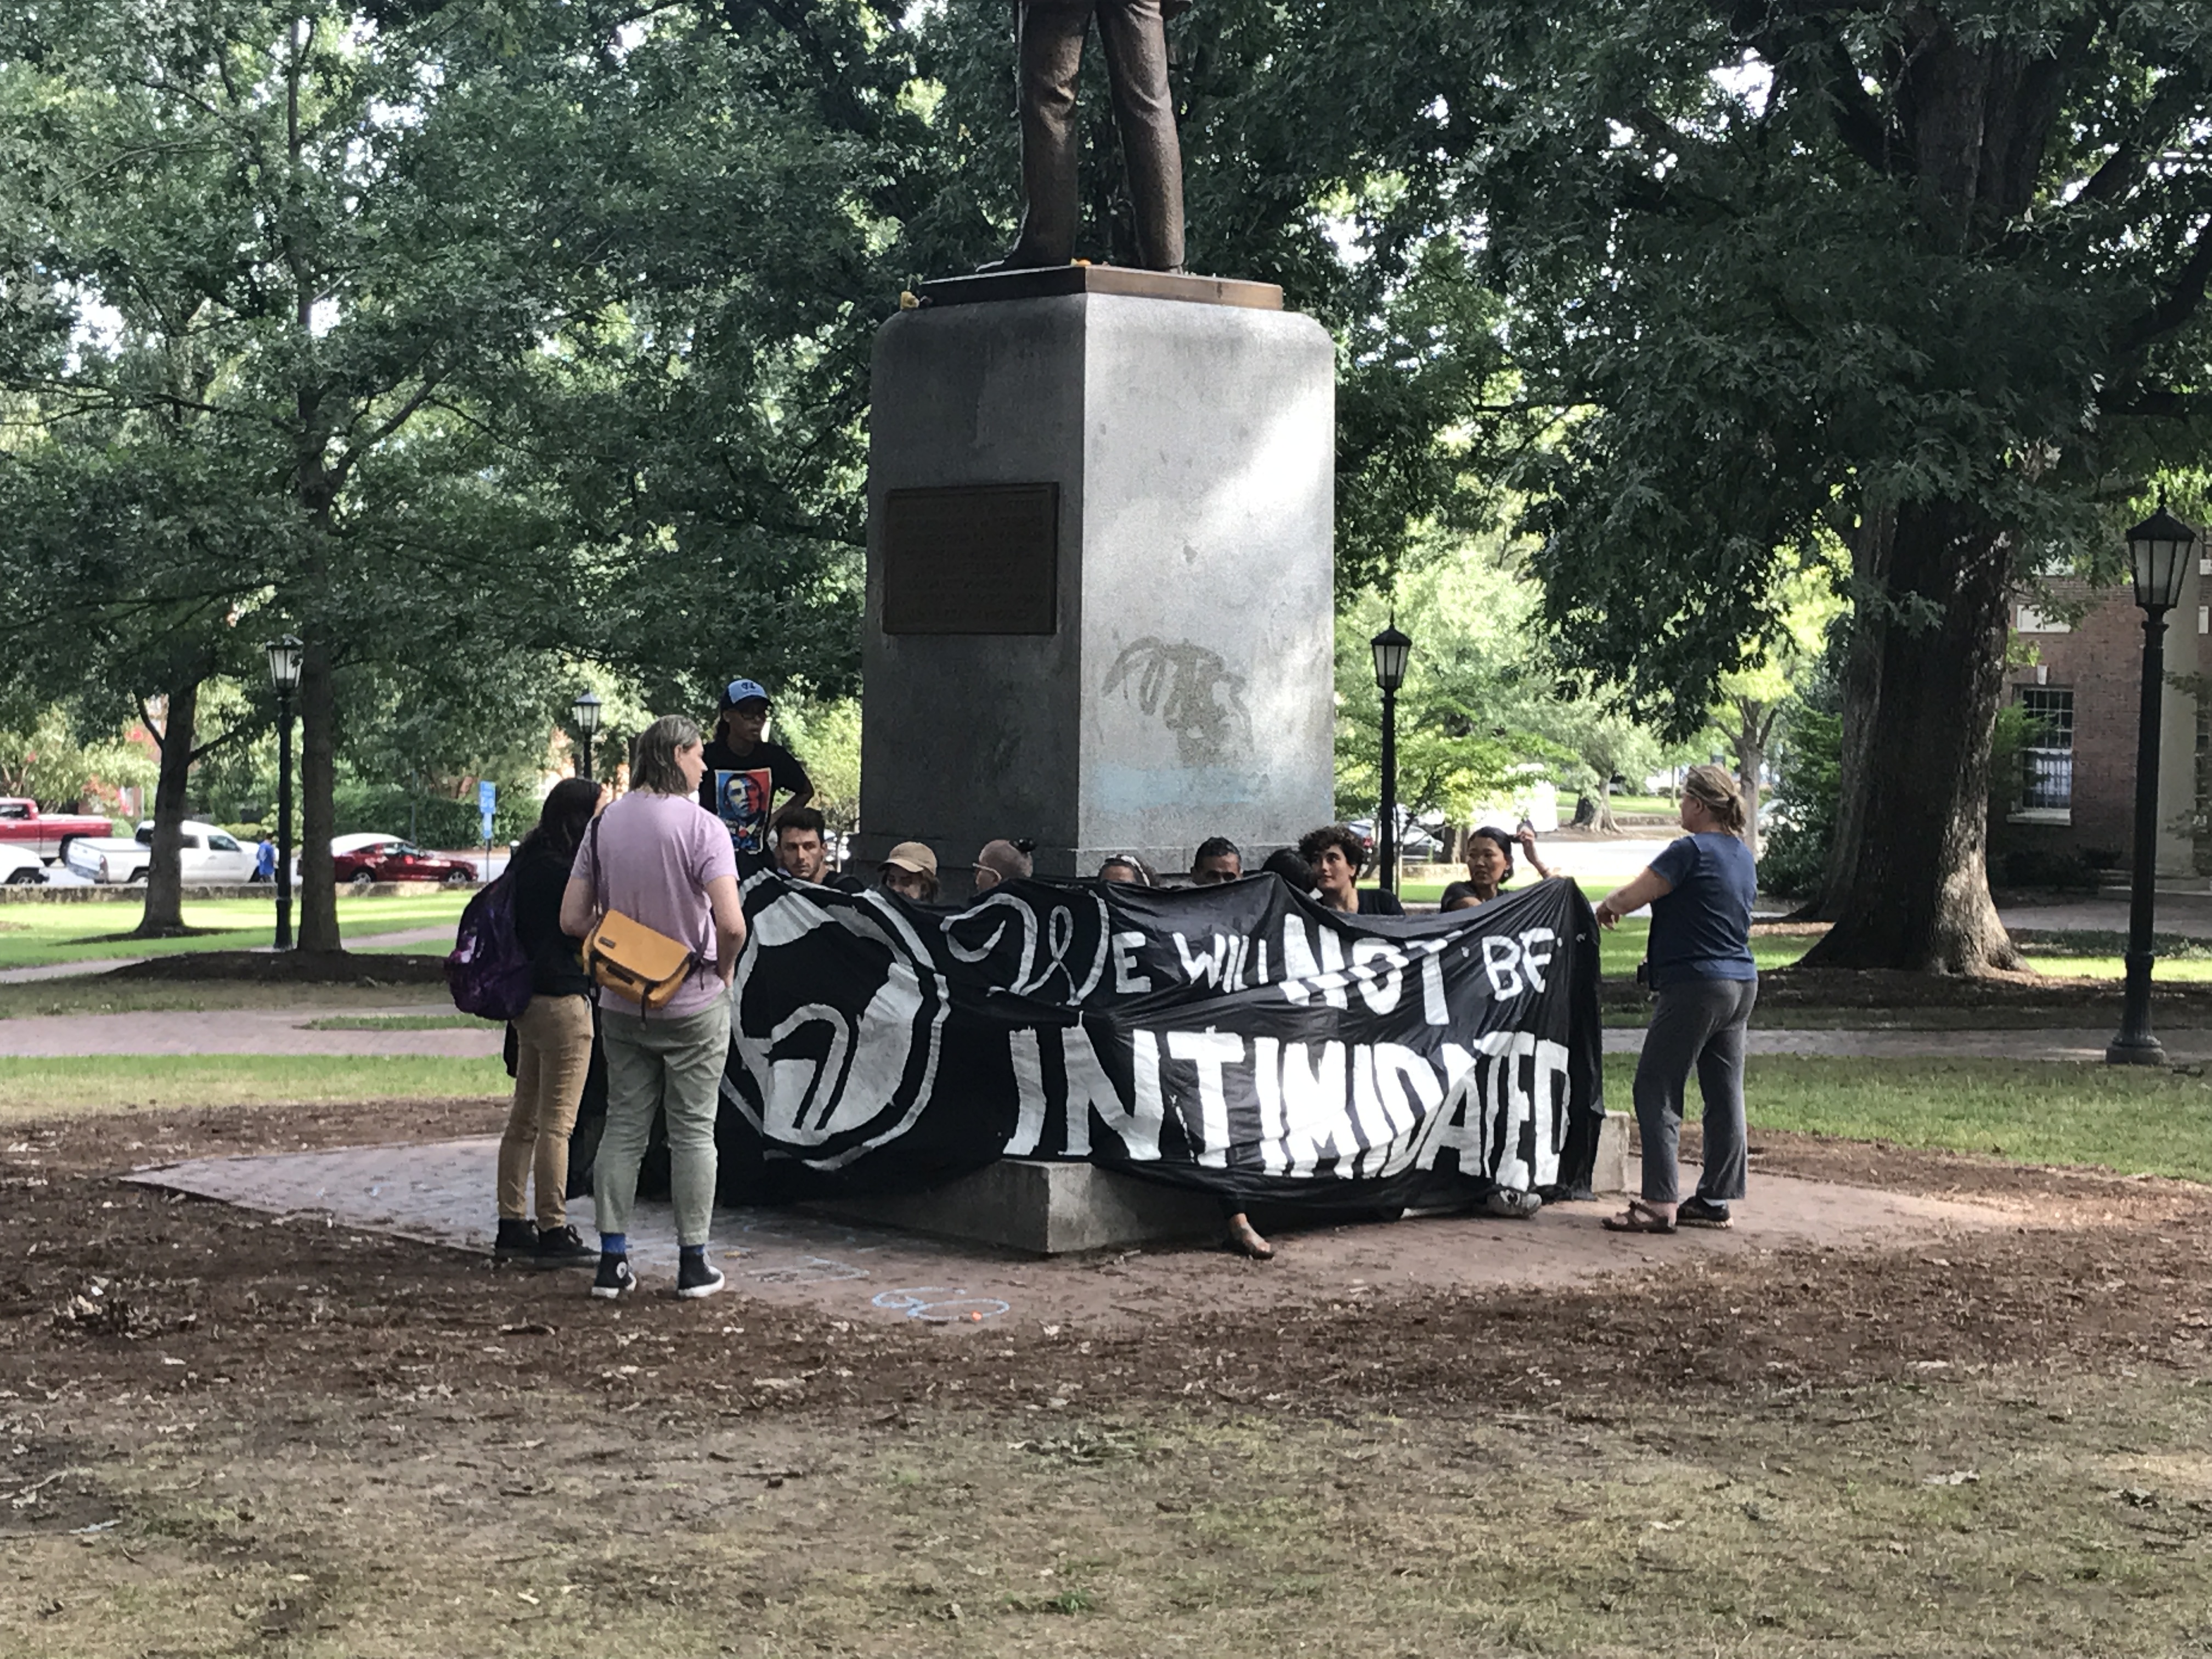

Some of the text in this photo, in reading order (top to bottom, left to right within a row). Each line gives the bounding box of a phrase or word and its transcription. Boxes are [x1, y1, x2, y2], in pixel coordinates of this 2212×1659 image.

[940, 889, 1555, 1025] WE WILL NOT BE
[1003, 1022, 1570, 1192] INTIMIDATED
